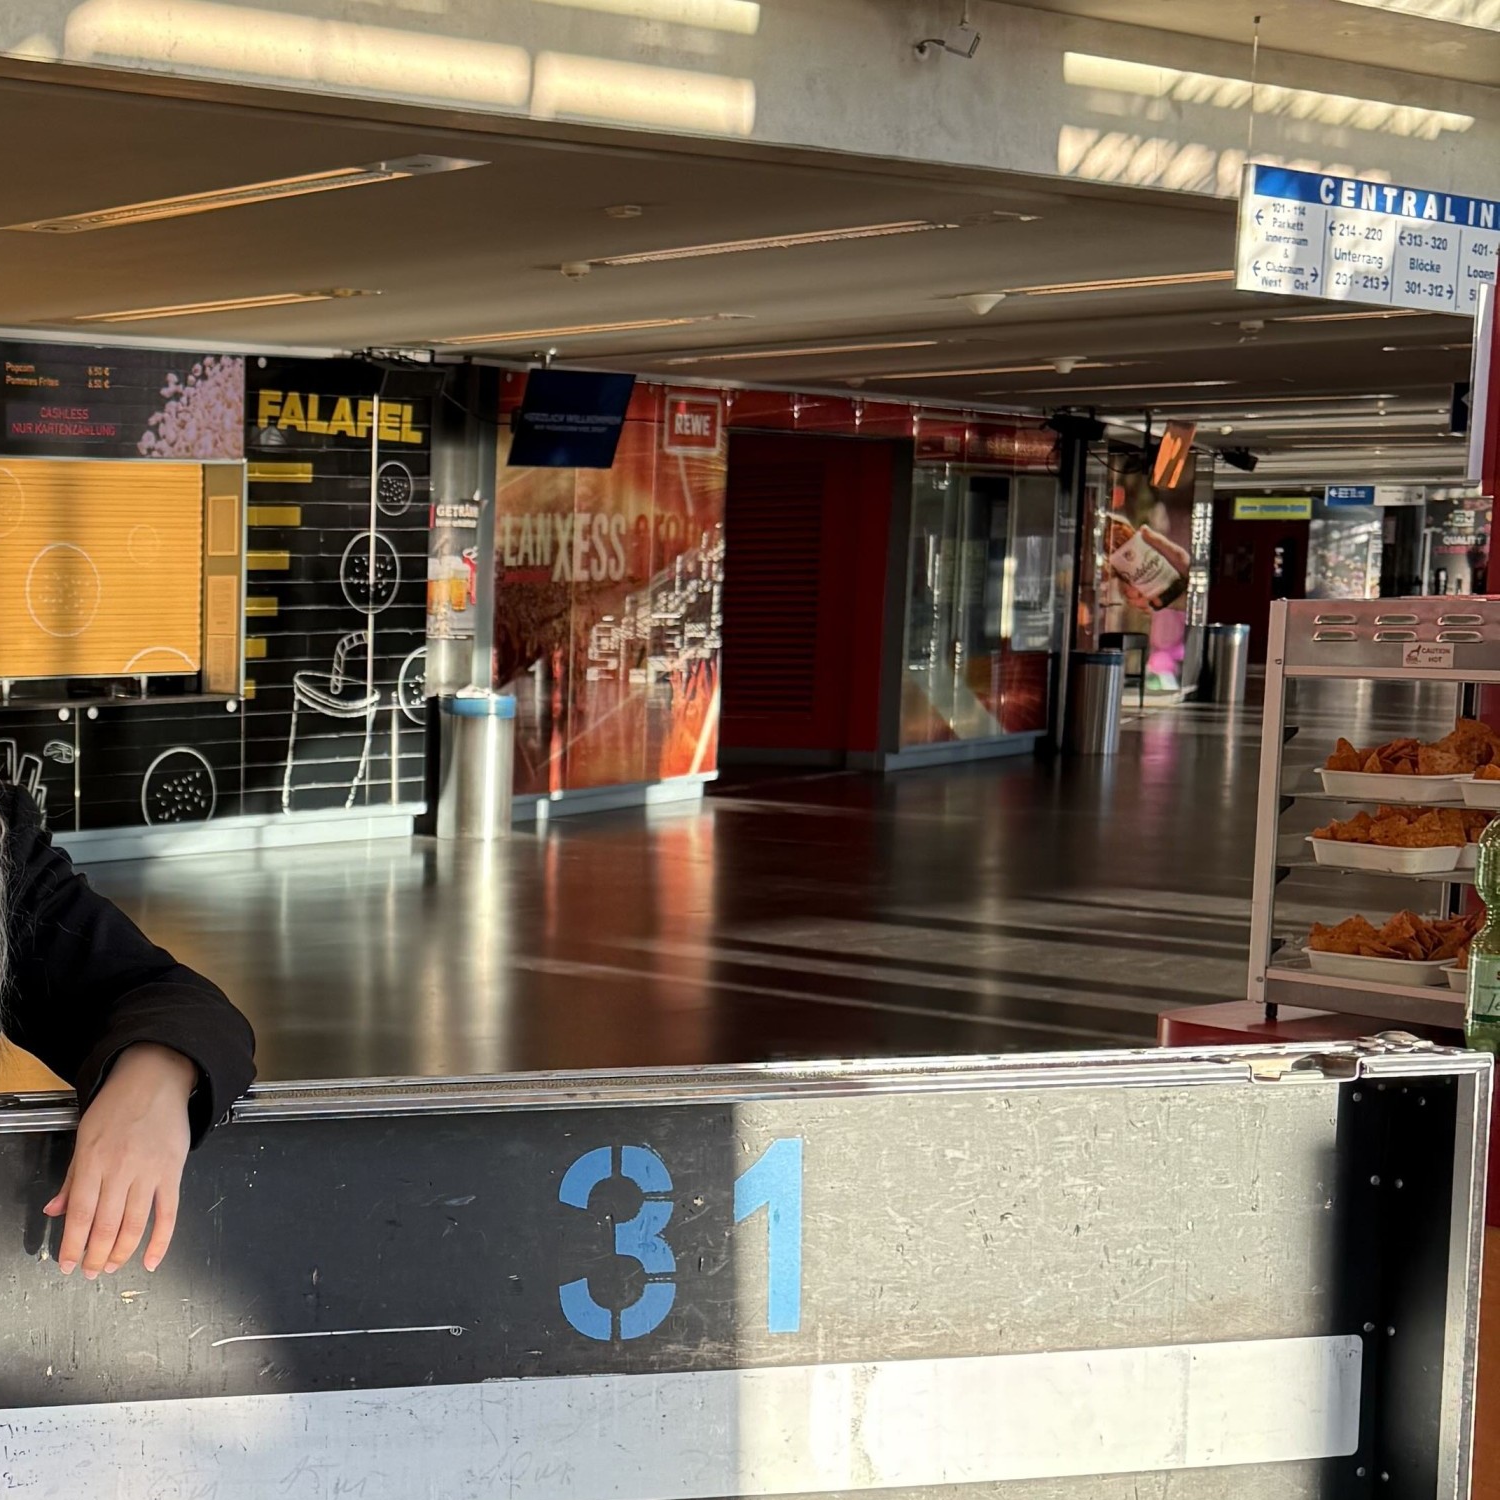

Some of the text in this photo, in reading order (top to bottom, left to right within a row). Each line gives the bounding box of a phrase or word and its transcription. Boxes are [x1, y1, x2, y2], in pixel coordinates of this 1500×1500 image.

[1320, 178, 1500, 229] CENTRAL IN
[1272, 217, 1304, 231] Parkett
[1339, 223, 1356, 237] 214
[1364, 227, 1382, 241] 220
[1406, 233, 1423, 247] 313
[1431, 235, 1448, 251] 320
[1335, 248, 1383, 269] Unterrang
[1409, 257, 1441, 274] Blöcke
[1266, 261, 1305, 276] Clubraum
[1261, 276, 1309, 291] West Ost
[1363, 275, 1380, 290] 213
[40, 406, 90, 420] CASHLESS
[257, 389, 422, 444] FALAFEL
[12, 422, 116, 437] NUR KARTENZAHLUNG
[674, 413, 711, 436] REWE
[503, 512, 626, 582] LANXESS
